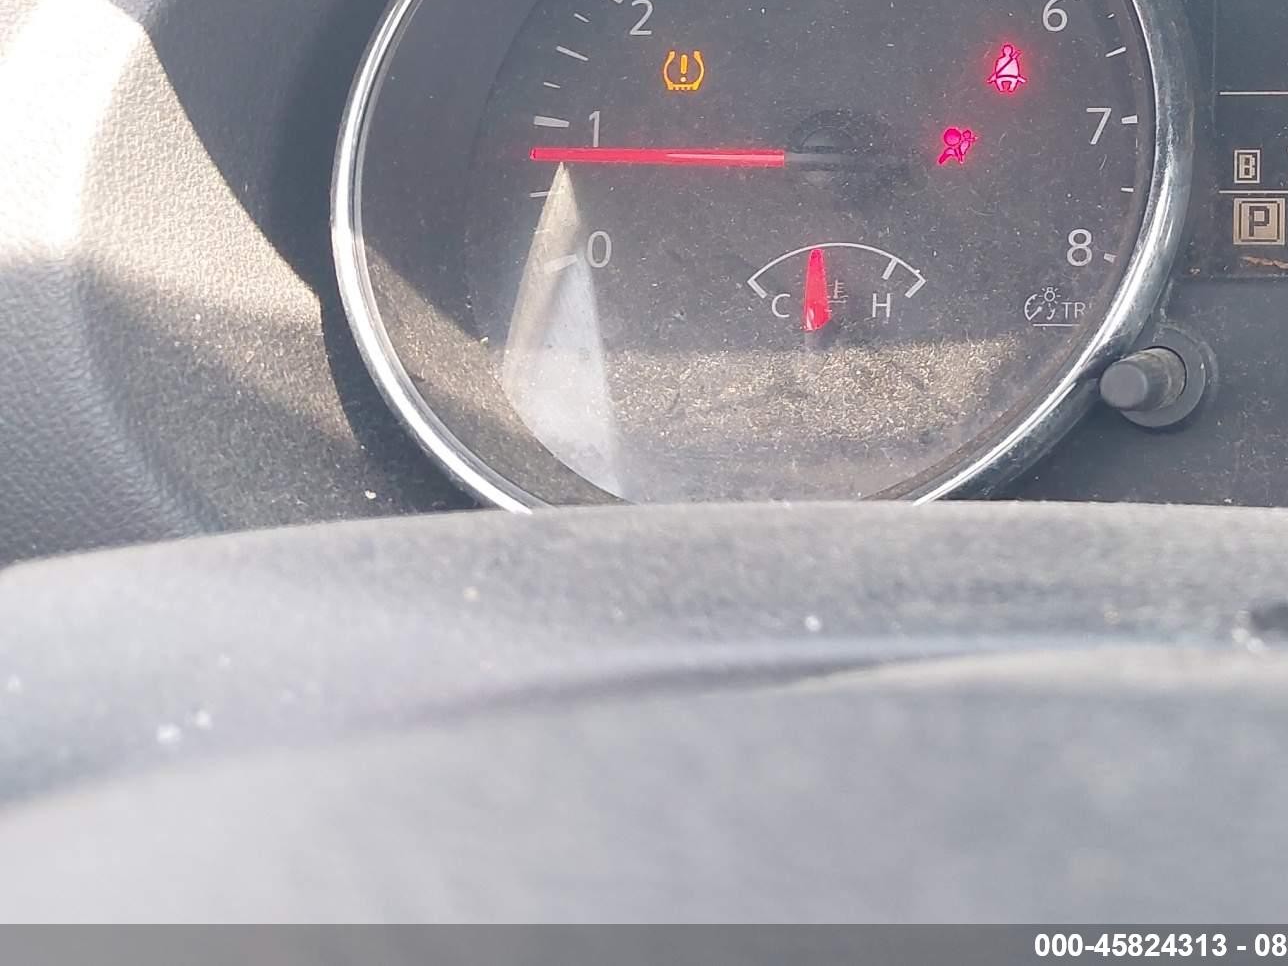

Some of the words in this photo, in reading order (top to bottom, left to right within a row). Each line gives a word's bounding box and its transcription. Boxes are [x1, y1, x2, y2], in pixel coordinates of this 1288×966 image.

[630, 0, 653, 34] 2
[588, 110, 601, 148] 1
[1086, 108, 1111, 144] 7
[587, 230, 612, 268] 0
[1067, 229, 1092, 266] 8
[772, 294, 790, 318] C
[871, 294, 891, 318] H
